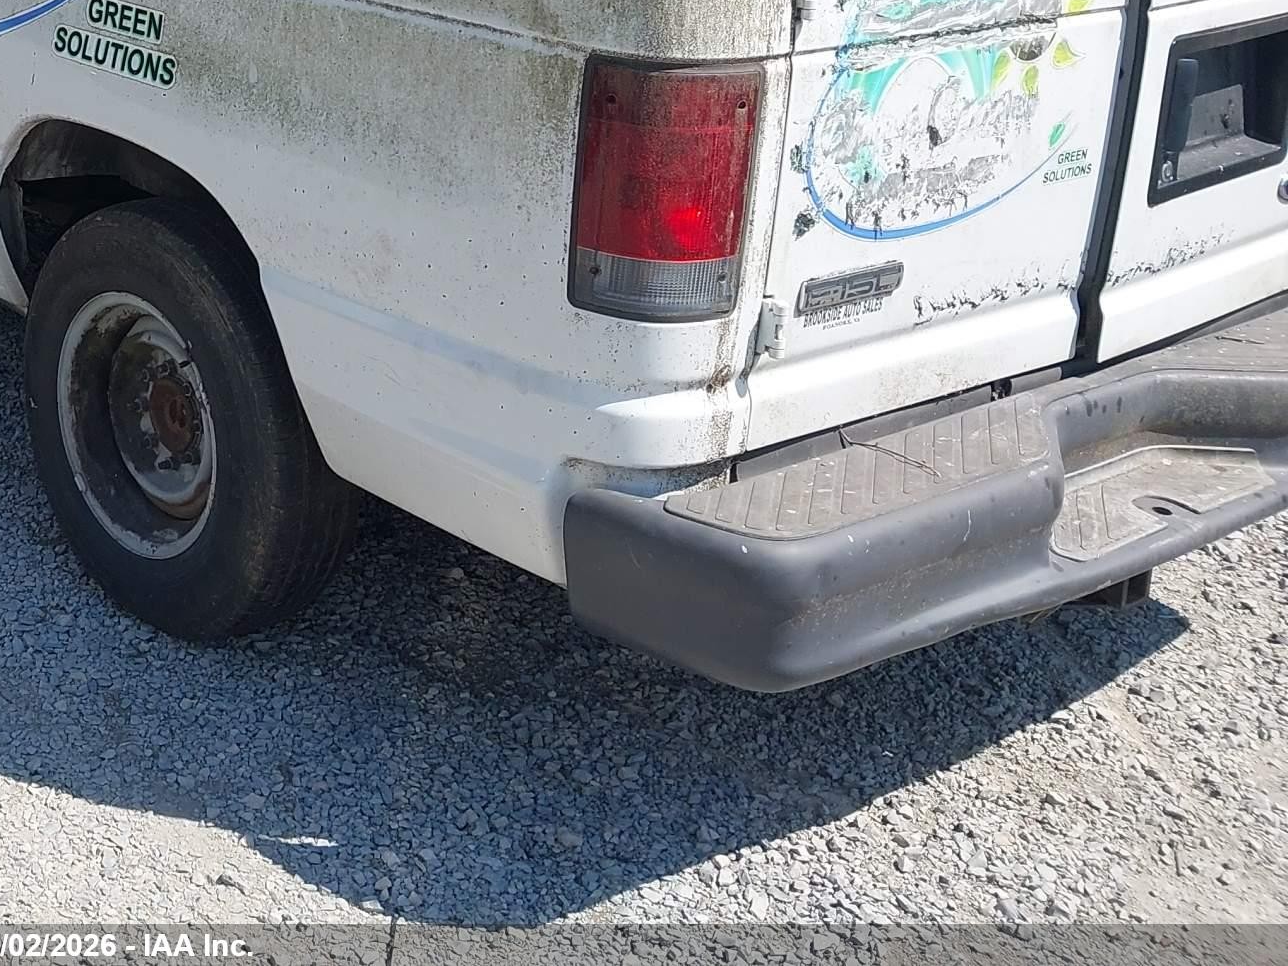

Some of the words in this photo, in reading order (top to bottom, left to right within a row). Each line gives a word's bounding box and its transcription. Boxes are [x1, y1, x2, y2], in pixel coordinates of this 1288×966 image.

[54, 27, 175, 85] SOLUTIONS
[1058, 148, 1088, 164] GREEN
[1043, 163, 1092, 183] SOLUTIONS
[803, 304, 842, 328] BROOKSIDE
[844, 300, 861, 318] AUTO
[862, 296, 884, 315] SALES
